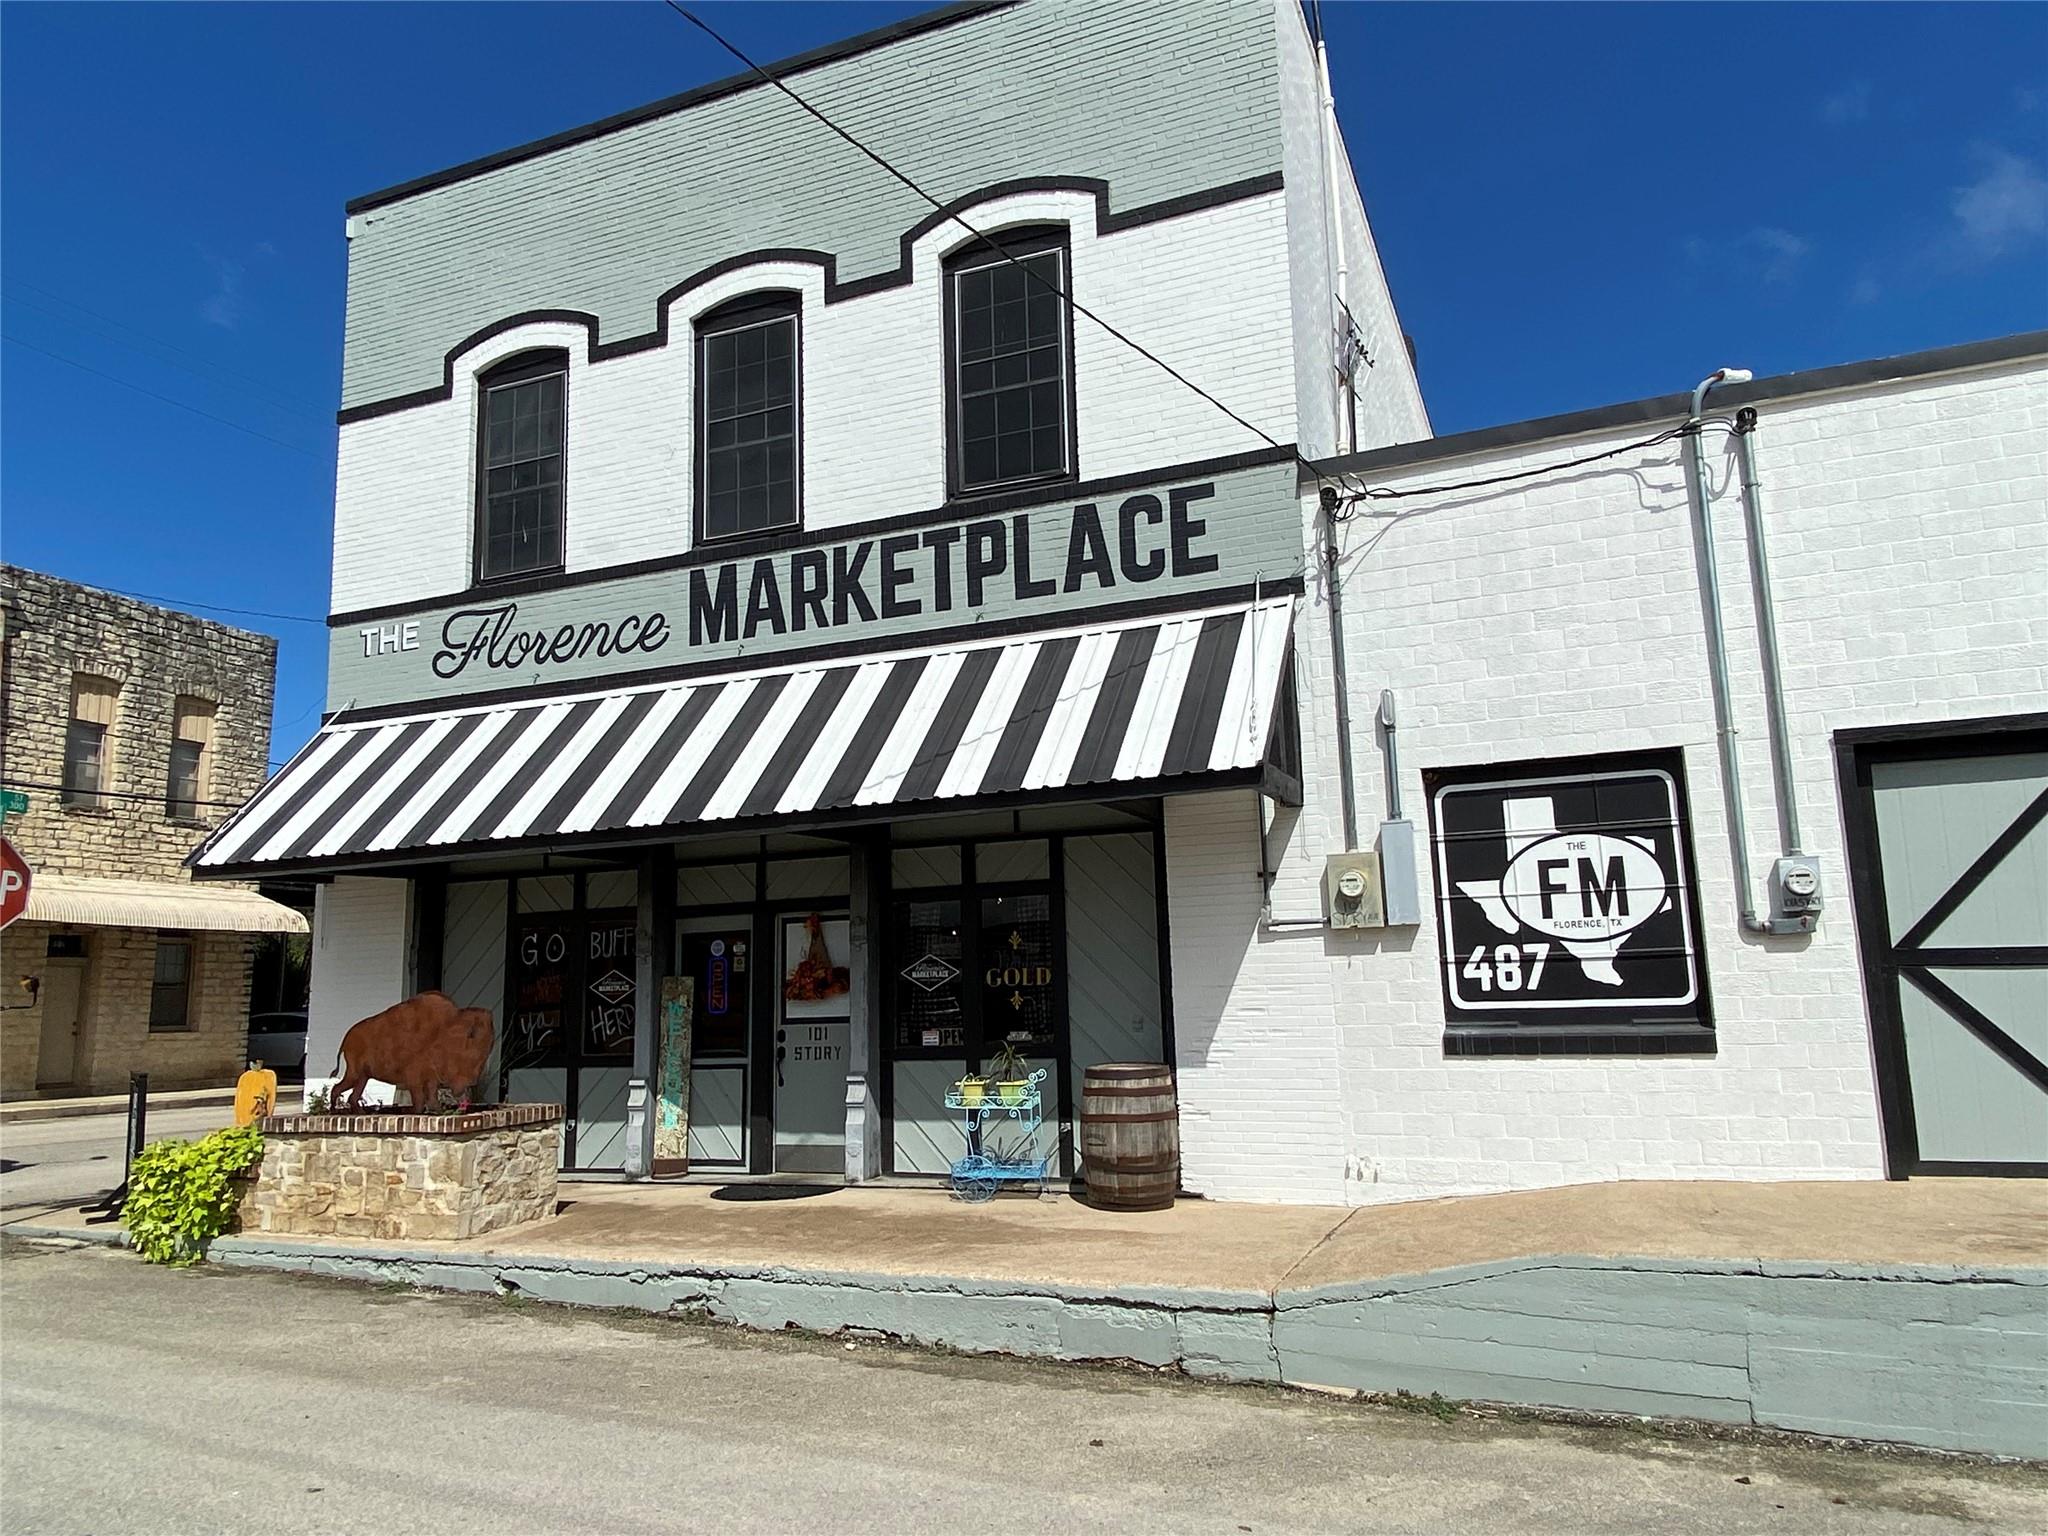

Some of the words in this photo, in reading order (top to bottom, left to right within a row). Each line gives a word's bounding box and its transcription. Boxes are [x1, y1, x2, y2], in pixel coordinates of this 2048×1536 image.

[360, 620, 420, 657] THE
[431, 601, 669, 679] Florence
[688, 480, 1221, 646] MARKETPLACE
[1566, 841, 1587, 851] THE
[1537, 856, 1630, 920] FM
[1611, 918, 1623, 928] TX
[521, 932, 566, 966] GO
[590, 927, 637, 960] BUFF
[985, 967, 1053, 988] GOLD
[1463, 943, 1550, 992] 487
[807, 1026, 828, 1041] 101
[794, 1046, 842, 1061] STORY
